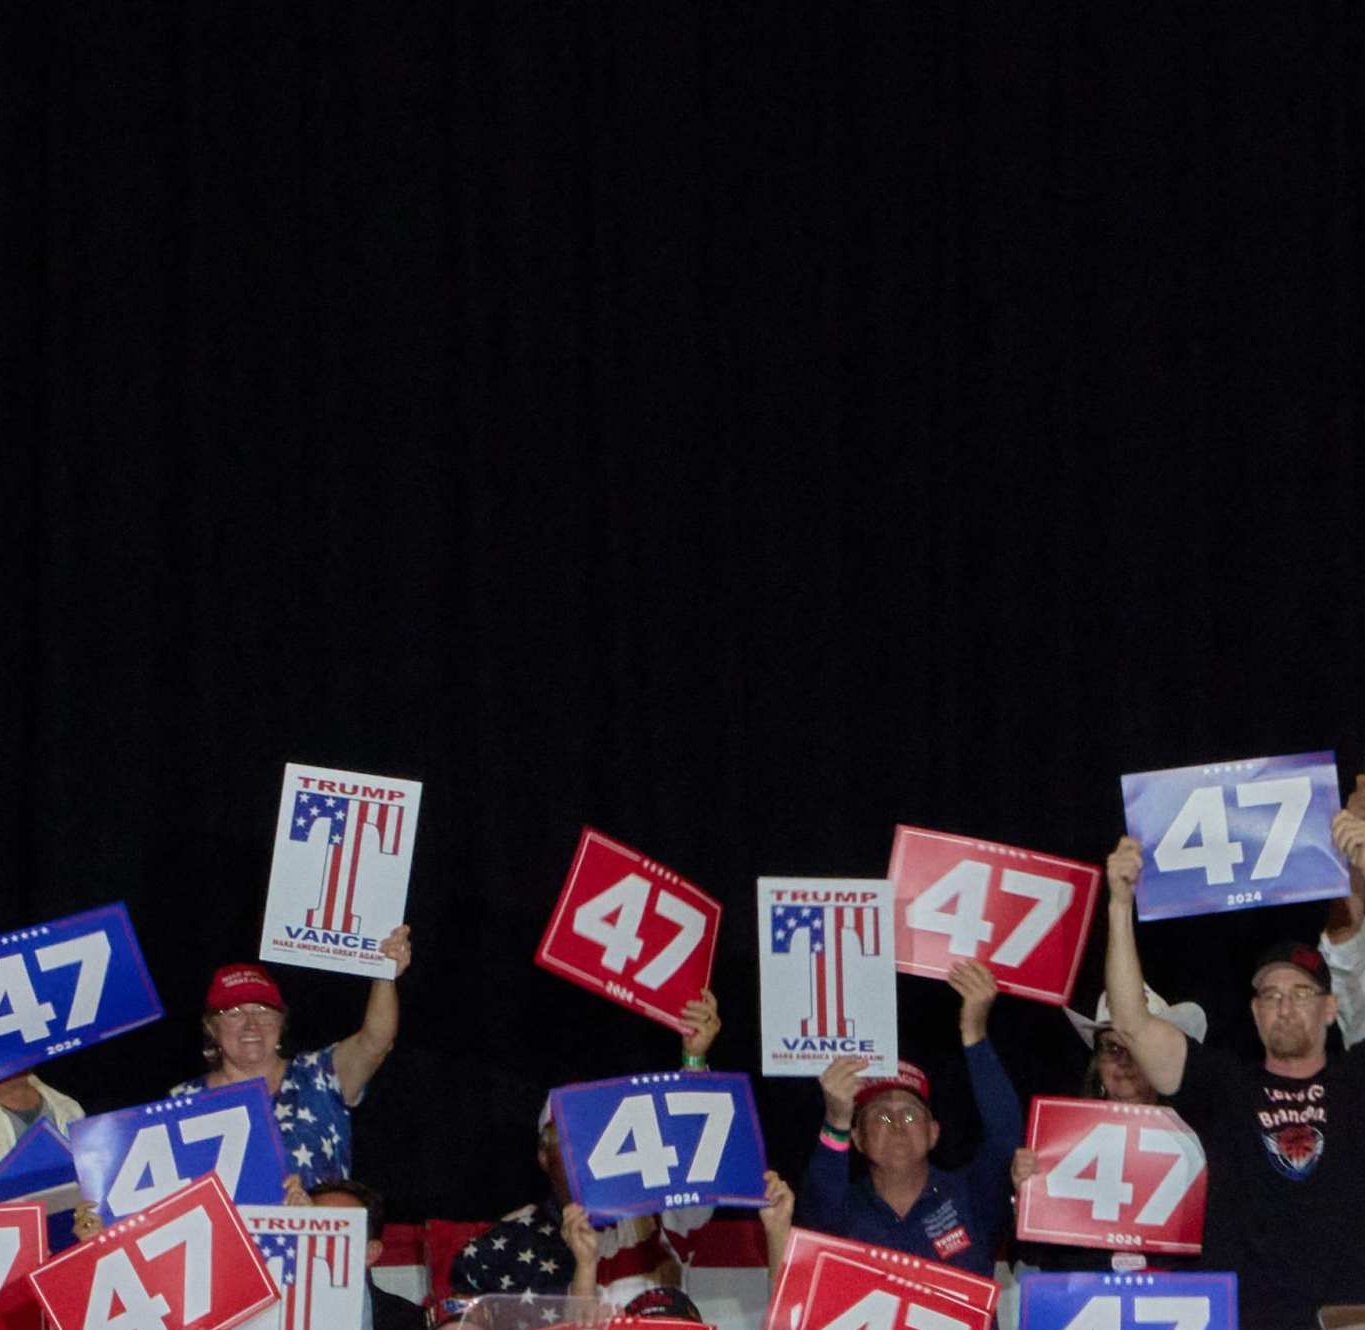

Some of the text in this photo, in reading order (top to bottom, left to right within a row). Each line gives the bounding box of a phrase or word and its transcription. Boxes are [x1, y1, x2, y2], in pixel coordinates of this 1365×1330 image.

[298, 776, 406, 802] TRUMP
[1153, 777, 1312, 886] 47
[770, 890, 878, 903] TRUMP
[1227, 891, 1262, 905] 2024
[905, 859, 1075, 968] 47
[285, 926, 378, 951] VANCE
[573, 873, 707, 991] 47
[46, 1038, 82, 1055] 2024
[782, 1039, 875, 1053] VANCE
[588, 1092, 734, 1190] 47
[106, 1106, 251, 1218] 47
[1046, 1123, 1206, 1227] 47
[665, 1192, 700, 1206] 2024
[249, 1217, 350, 1231] TRUMP
[1107, 1234, 1142, 1246] 2024
